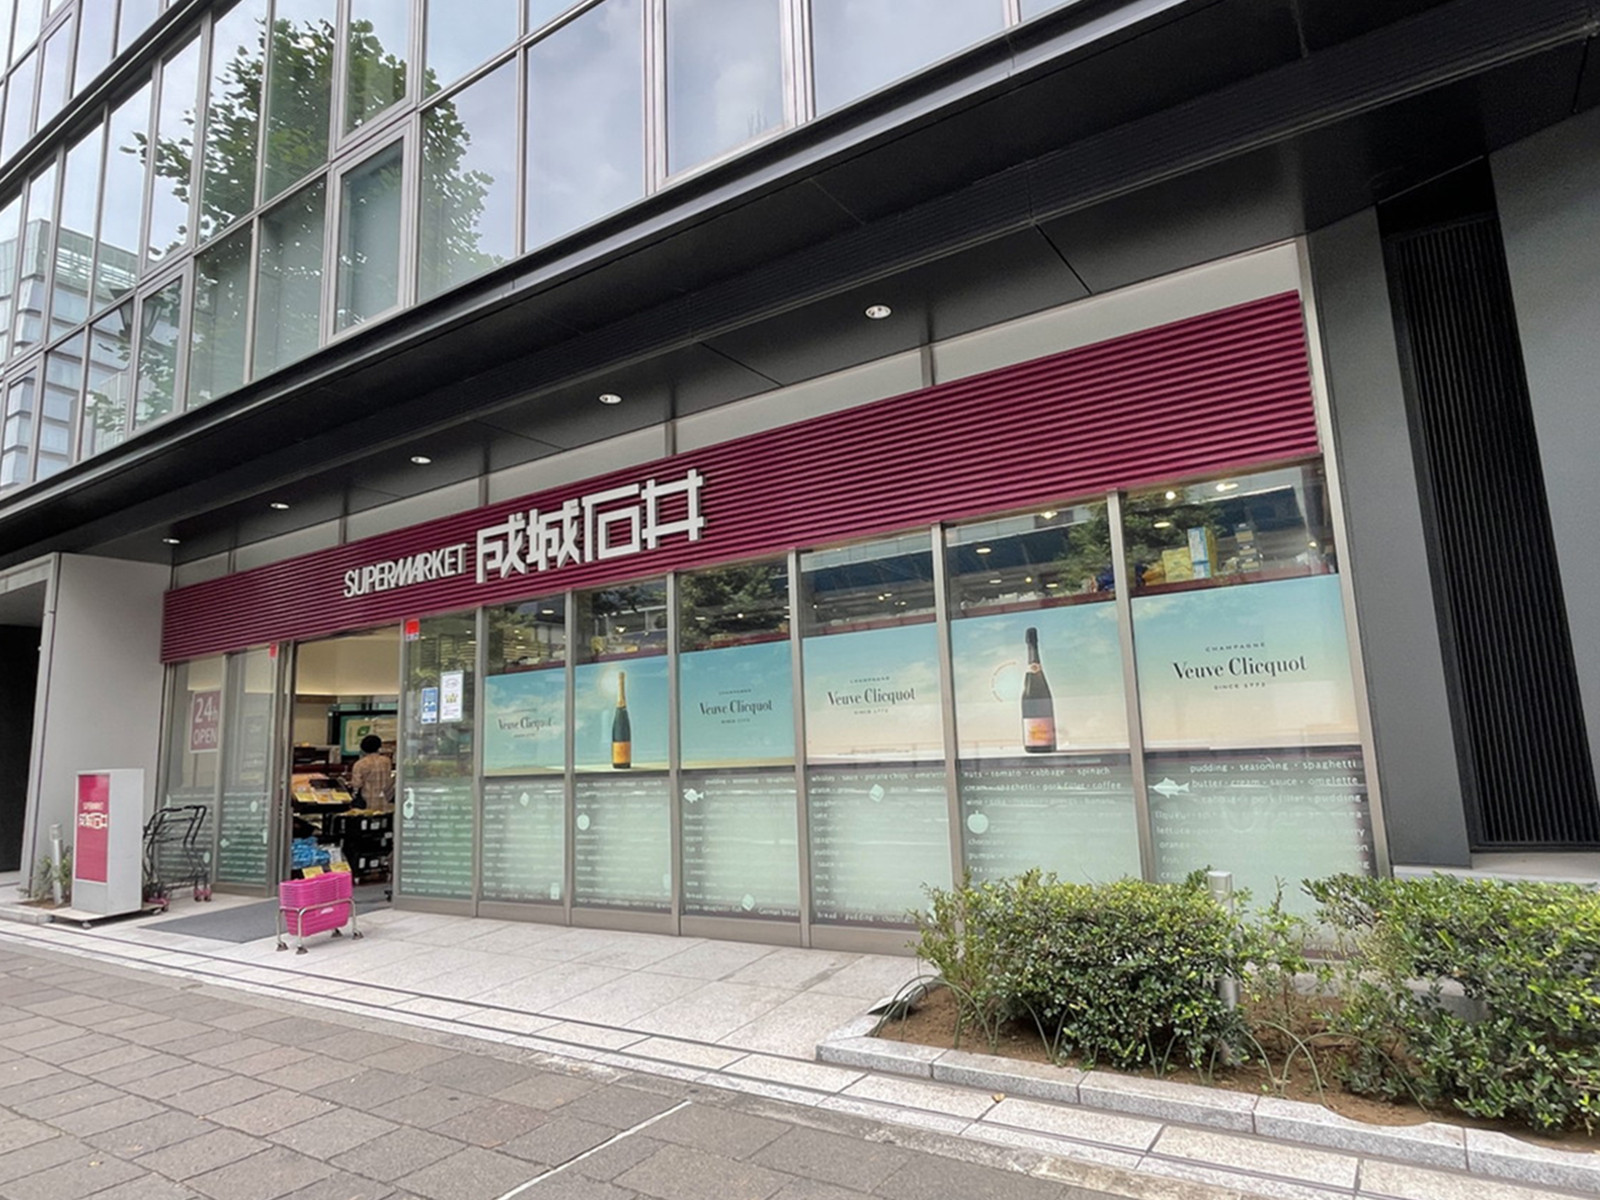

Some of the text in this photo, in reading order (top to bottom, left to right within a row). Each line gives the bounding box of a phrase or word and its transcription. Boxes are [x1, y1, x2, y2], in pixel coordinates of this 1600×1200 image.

[476, 468, 705, 585] 成城石井
[343, 543, 468, 598] SUPERMARKET
[1205, 642, 1265, 652] CHAMPAGNE
[1172, 655, 1308, 679] Veuve Clicquot
[827, 687, 916, 705] Veuve Clicquot
[699, 699, 772, 715] Veuve Clicquot
[1190, 760, 1357, 773] pudding seasoning spaghetti
[1092, 780, 1121, 789] coffee
[1307, 776, 1358, 786] omelette
